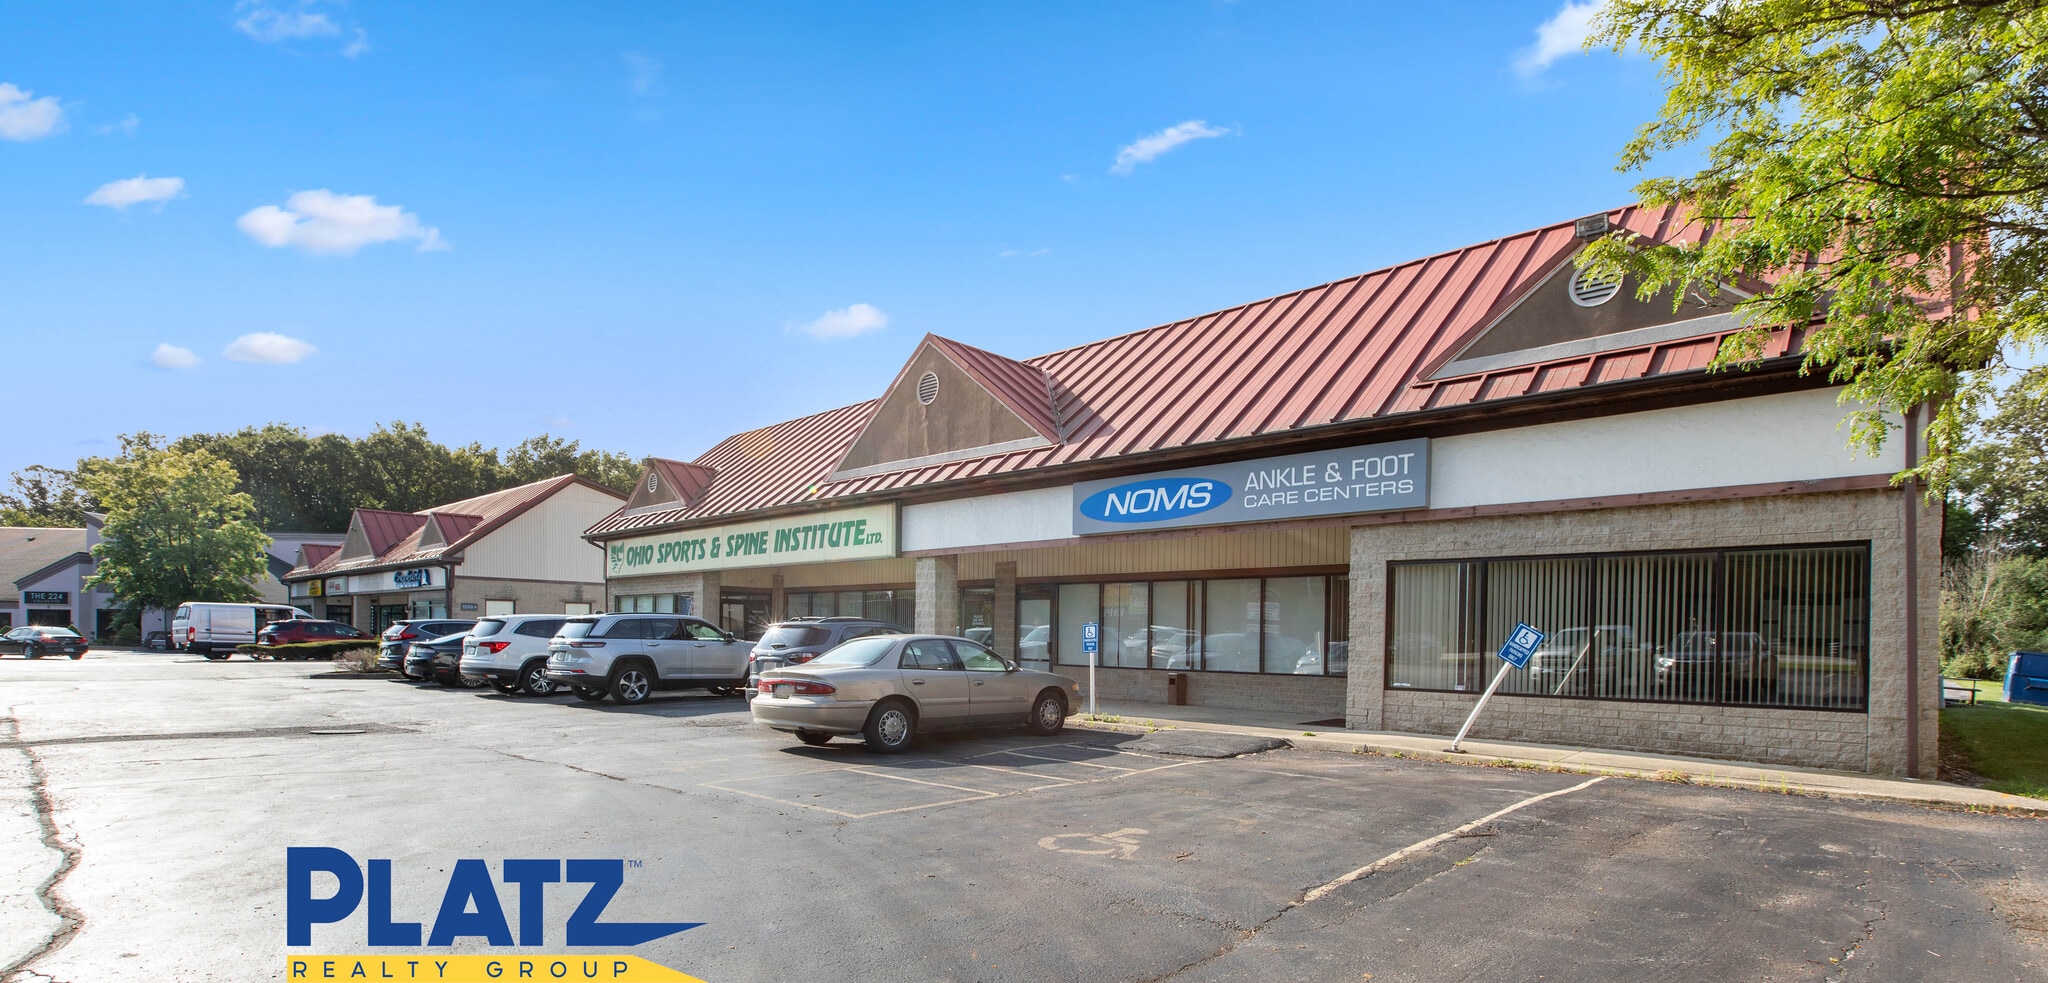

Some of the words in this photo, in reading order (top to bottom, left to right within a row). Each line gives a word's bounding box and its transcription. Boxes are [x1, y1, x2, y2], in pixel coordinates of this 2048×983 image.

[1244, 464, 1317, 492] ANKLE
[1324, 462, 1343, 483] &
[1351, 452, 1415, 480] FOOT
[1104, 482, 1214, 517] NOMS
[1244, 487, 1299, 509] CARE
[1304, 478, 1414, 503] CENTERS
[626, 544, 654, 569] OHIO
[657, 537, 706, 564] SPORTS
[710, 536, 721, 558] &
[726, 530, 769, 557] SPINE
[773, 519, 867, 553] INSTITUTE
[866, 531, 883, 545] LTD.
